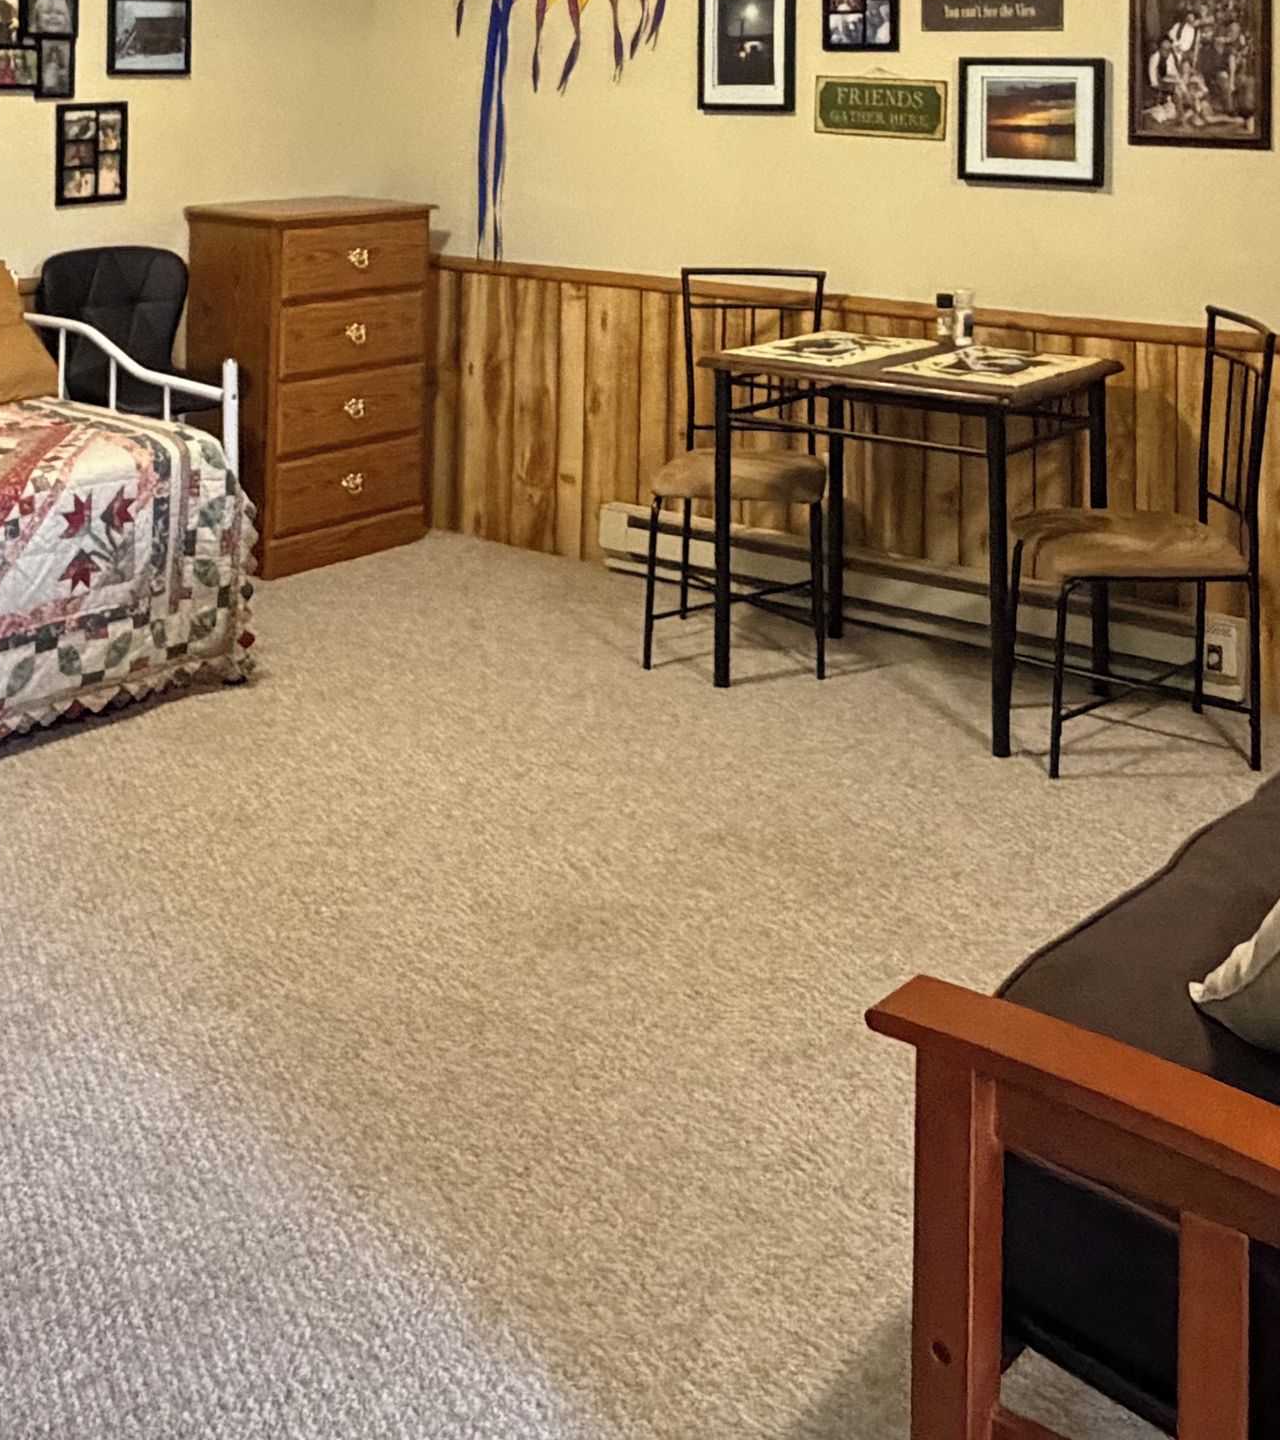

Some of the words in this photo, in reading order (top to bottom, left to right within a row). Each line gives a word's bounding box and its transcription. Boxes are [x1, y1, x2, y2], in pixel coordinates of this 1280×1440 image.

[943, 4, 960, 19] You
[960, 4, 982, 19] can't
[999, 3, 1014, 18] the
[1015, 3, 1037, 18] View
[836, 86, 924, 109] FRIENDS
[828, 109, 886, 125] GATHER
[886, 112, 930, 129] HERE
